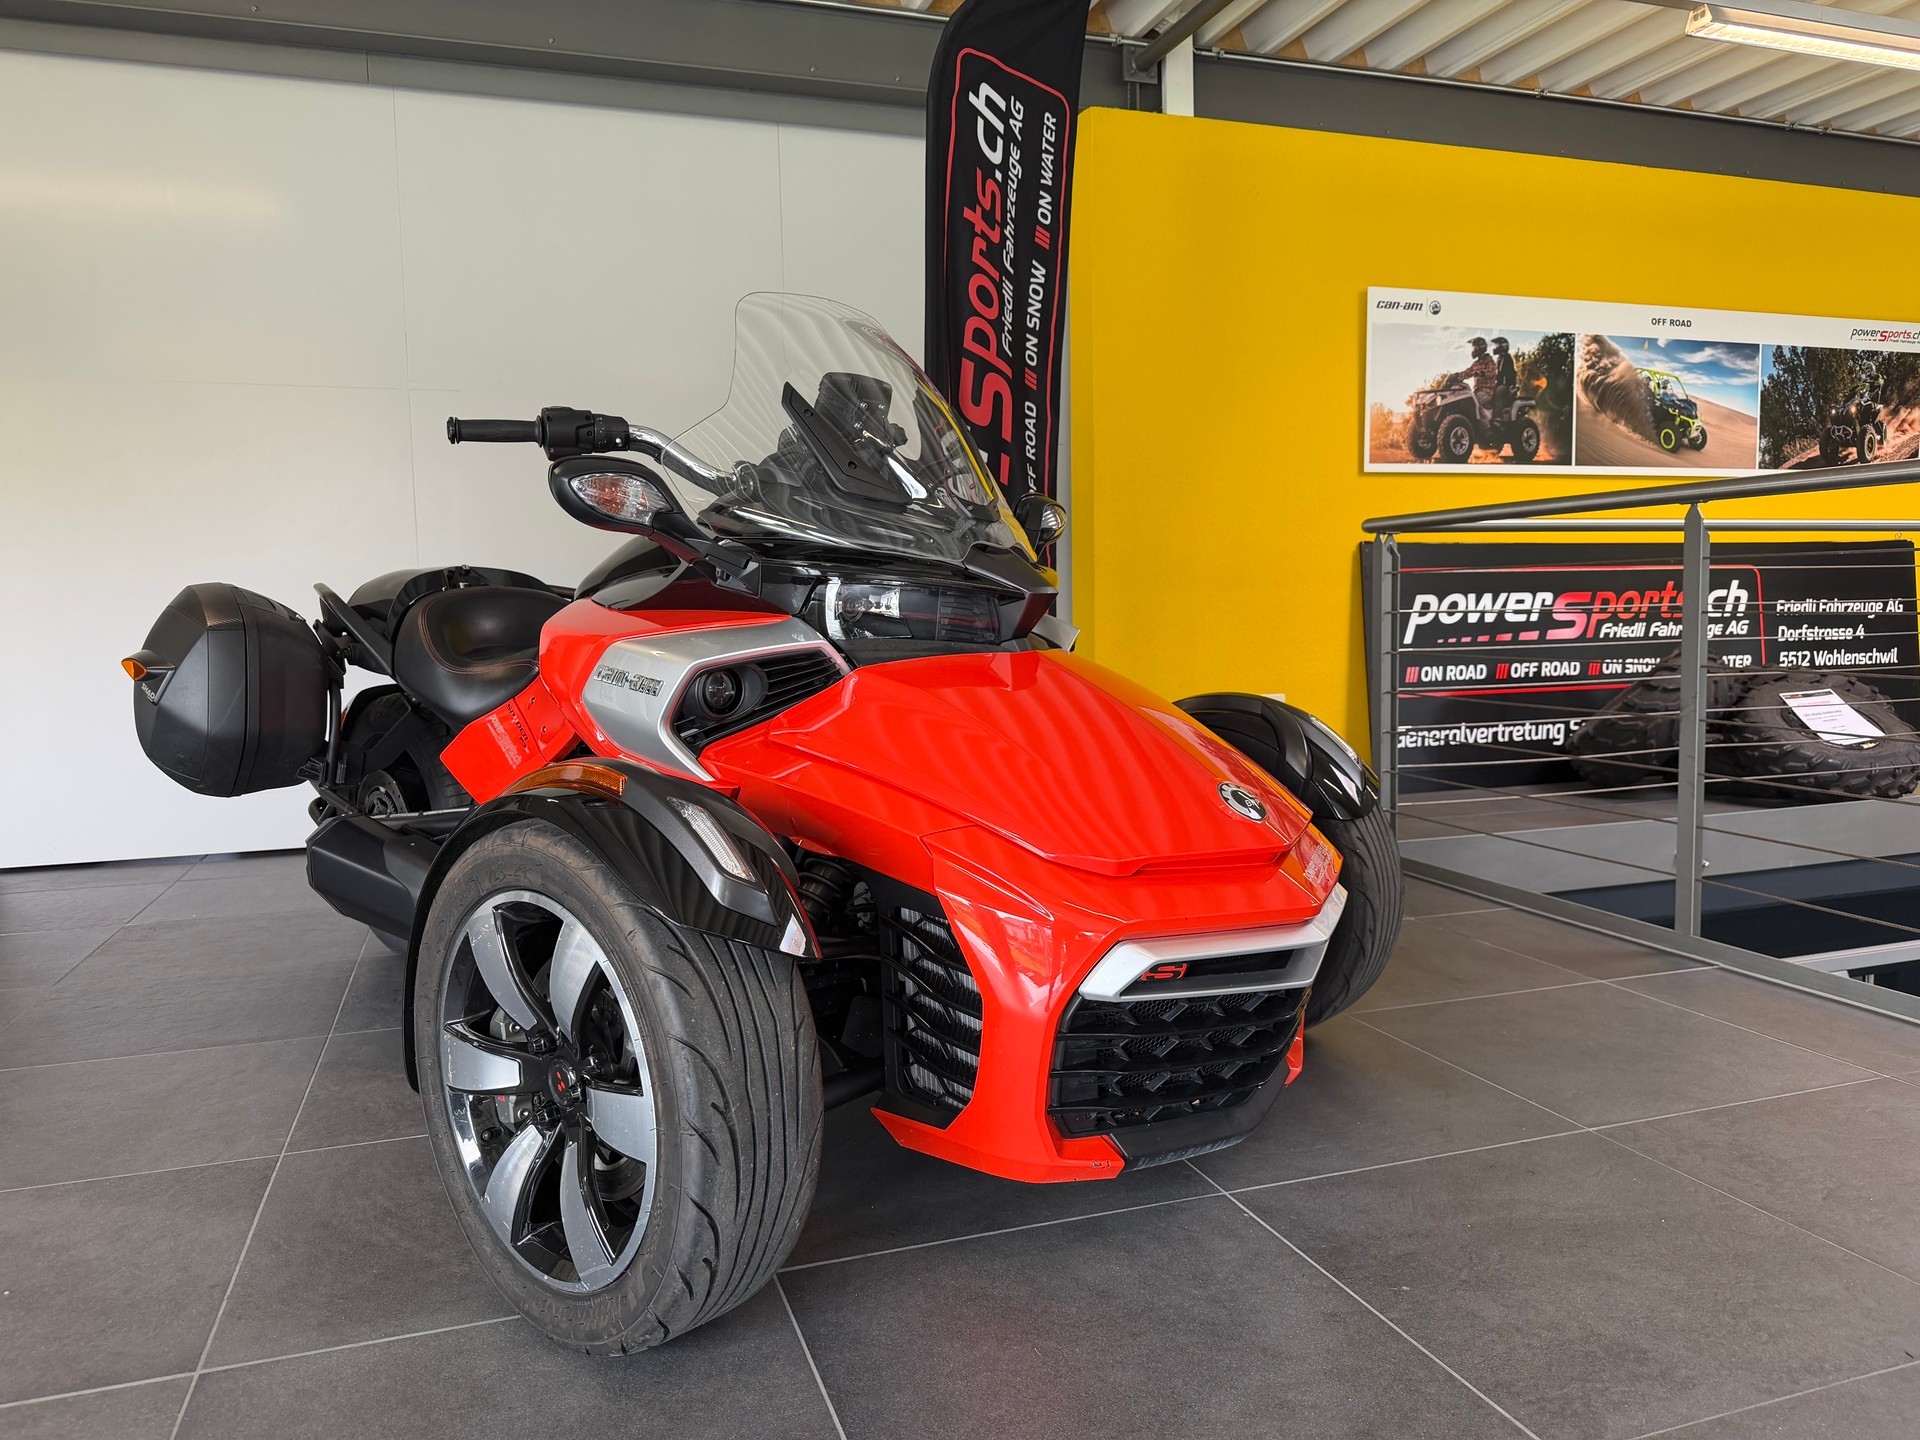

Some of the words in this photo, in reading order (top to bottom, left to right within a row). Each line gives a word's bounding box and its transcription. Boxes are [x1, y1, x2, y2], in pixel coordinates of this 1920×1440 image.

[1010, 95, 1025, 142] AG
[1038, 111, 1057, 187] WATER
[1003, 142, 1023, 276] Fahrzeuge
[1036, 190, 1052, 226] ON
[1026, 260, 1047, 331] SNOW
[1376, 300, 1424, 311] can-am
[1001, 275, 1014, 357] Friedli
[1651, 317, 1667, 327] OFF
[1669, 318, 1692, 328] ROAD
[1025, 333, 1038, 367] ON
[1024, 400, 1037, 460] ROAD
[1027, 462, 1038, 493] FF
[1776, 598, 1816, 616] Friedli
[1819, 597, 1884, 619] Fahrzeuge
[1885, 598, 1904, 614] AG
[1599, 621, 1647, 639] Friedli
[1648, 621, 1724, 639] Fahrge
[1724, 619, 1750, 636] AG
[1777, 624, 1854, 641] Dorfstrasse
[1855, 623, 1866, 640] 4
[1420, 666, 1445, 683] ON
[1446, 664, 1488, 681] ROAD
[1510, 662, 1539, 678] OFF
[1541, 661, 1581, 677] ROAD
[1602, 658, 1623, 674] ON
[1721, 654, 1752, 668] TER
[1779, 650, 1811, 667] 5512
[1813, 647, 1899, 666] Wohlenschwil
